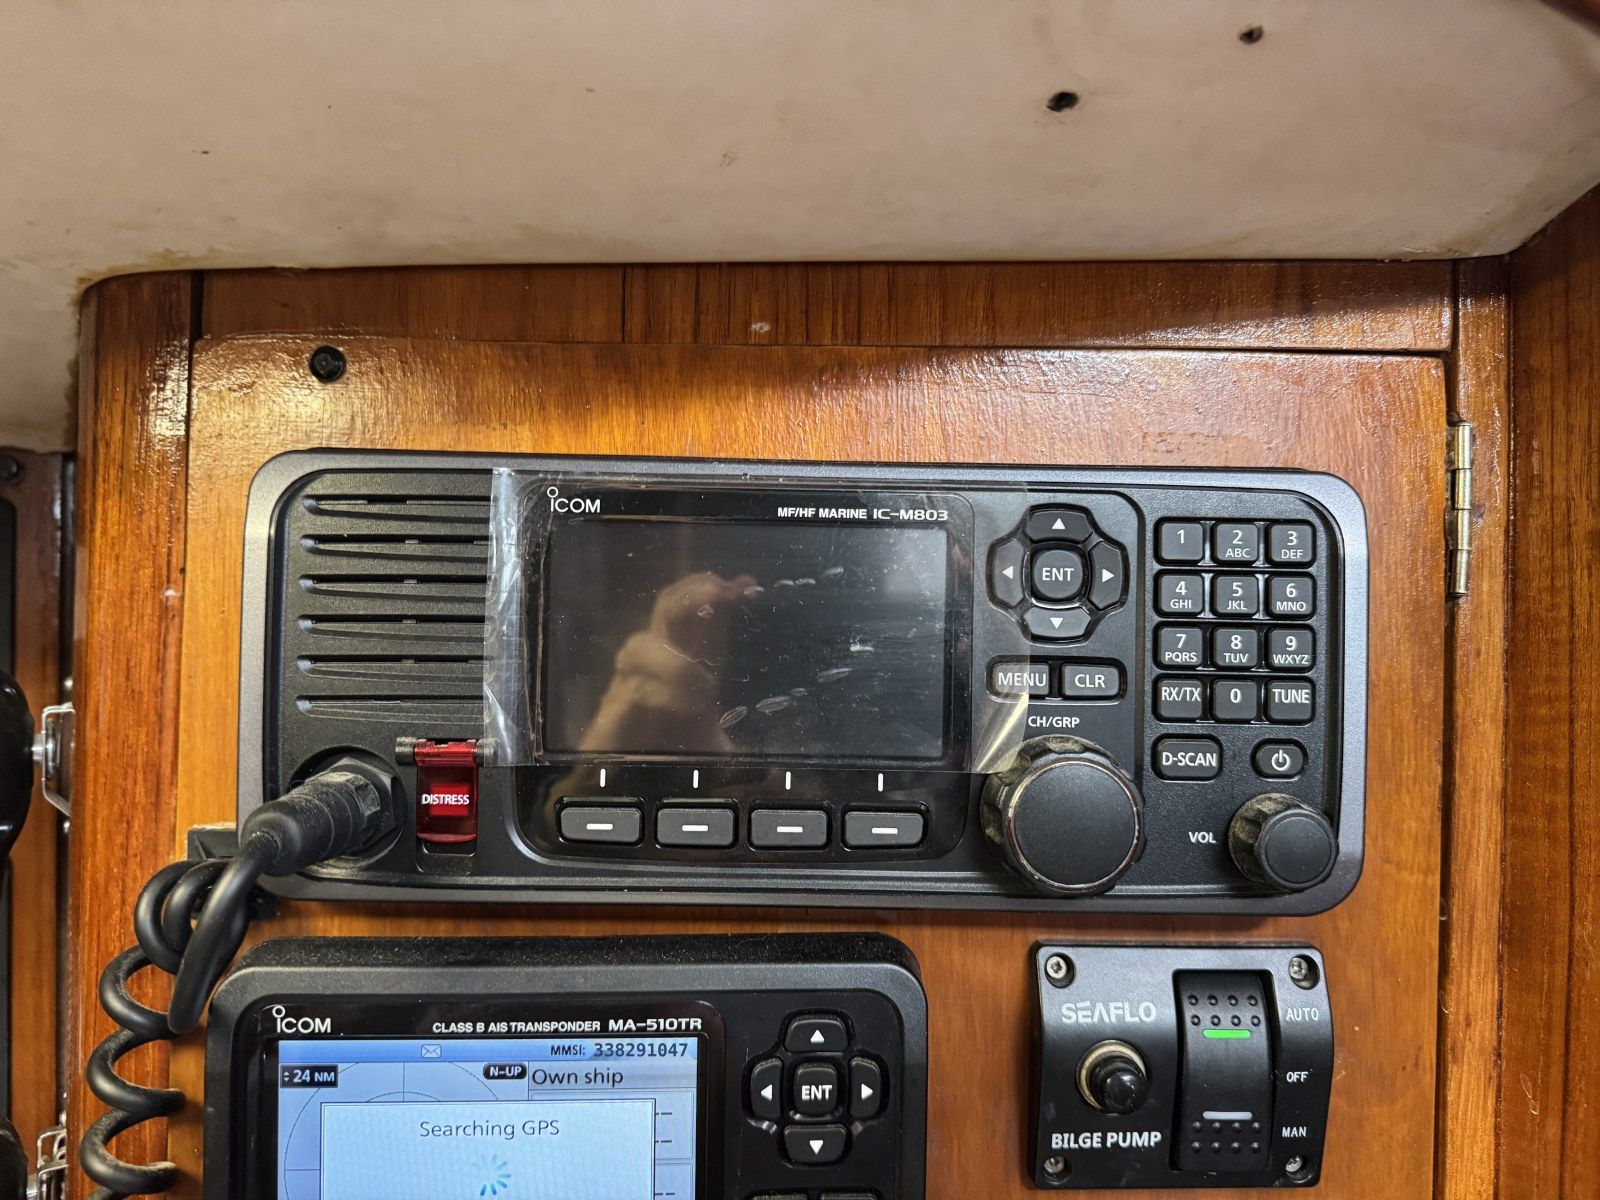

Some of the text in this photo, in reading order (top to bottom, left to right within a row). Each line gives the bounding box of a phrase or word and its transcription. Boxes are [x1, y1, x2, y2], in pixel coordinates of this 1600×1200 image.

[777, 507, 948, 521] MF/HF MARINE IC-M803
[1177, 529, 1186, 544] 1
[1232, 530, 1243, 545] 2
[1287, 531, 1297, 546] 3
[1225, 547, 1251, 559] ABC
[1281, 548, 1303, 559] DEF
[1041, 567, 1075, 582] ENT
[1175, 580, 1187, 595] 4
[1232, 582, 1243, 597] 5
[1286, 583, 1297, 598] 6
[1170, 598, 1192, 609] GHI
[1227, 599, 1247, 611] JKL
[1276, 600, 1306, 612] MNO
[1176, 634, 1187, 648] 7
[1231, 635, 1242, 650] 8
[1285, 636, 1297, 651] 9
[1165, 652, 1198, 664] PQRS
[1223, 652, 1248, 664] TUV
[1273, 653, 1309, 665] WXYZ
[998, 672, 1047, 687] MENU
[1074, 673, 1106, 688] CLR
[1161, 687, 1201, 703] RX/TX
[1273, 689, 1310, 704] TUNE
[1028, 715, 1080, 729] CH/GRP
[1162, 752, 1217, 768] D-SCAN
[421, 793, 470, 806] DISTRESS
[1188, 831, 1216, 844] VOL
[1061, 1001, 1157, 1024] SEAFLO
[1286, 1008, 1319, 1022] AUTO
[432, 1018, 702, 1034] CLASS B AIS TRANSPONDER MA-510TR
[550, 1042, 688, 1058] MMSI: 338291047
[293, 1068, 335, 1084] 24 NM
[489, 1064, 522, 1077] N-UP
[531, 1067, 624, 1089] Own ship
[1286, 1071, 1309, 1083] OFF
[801, 1084, 833, 1101] ENT
[419, 1119, 561, 1140] Searching GPS
[1281, 1126, 1308, 1138] MAN
[1051, 1131, 1162, 1150] BILGE PUMP
